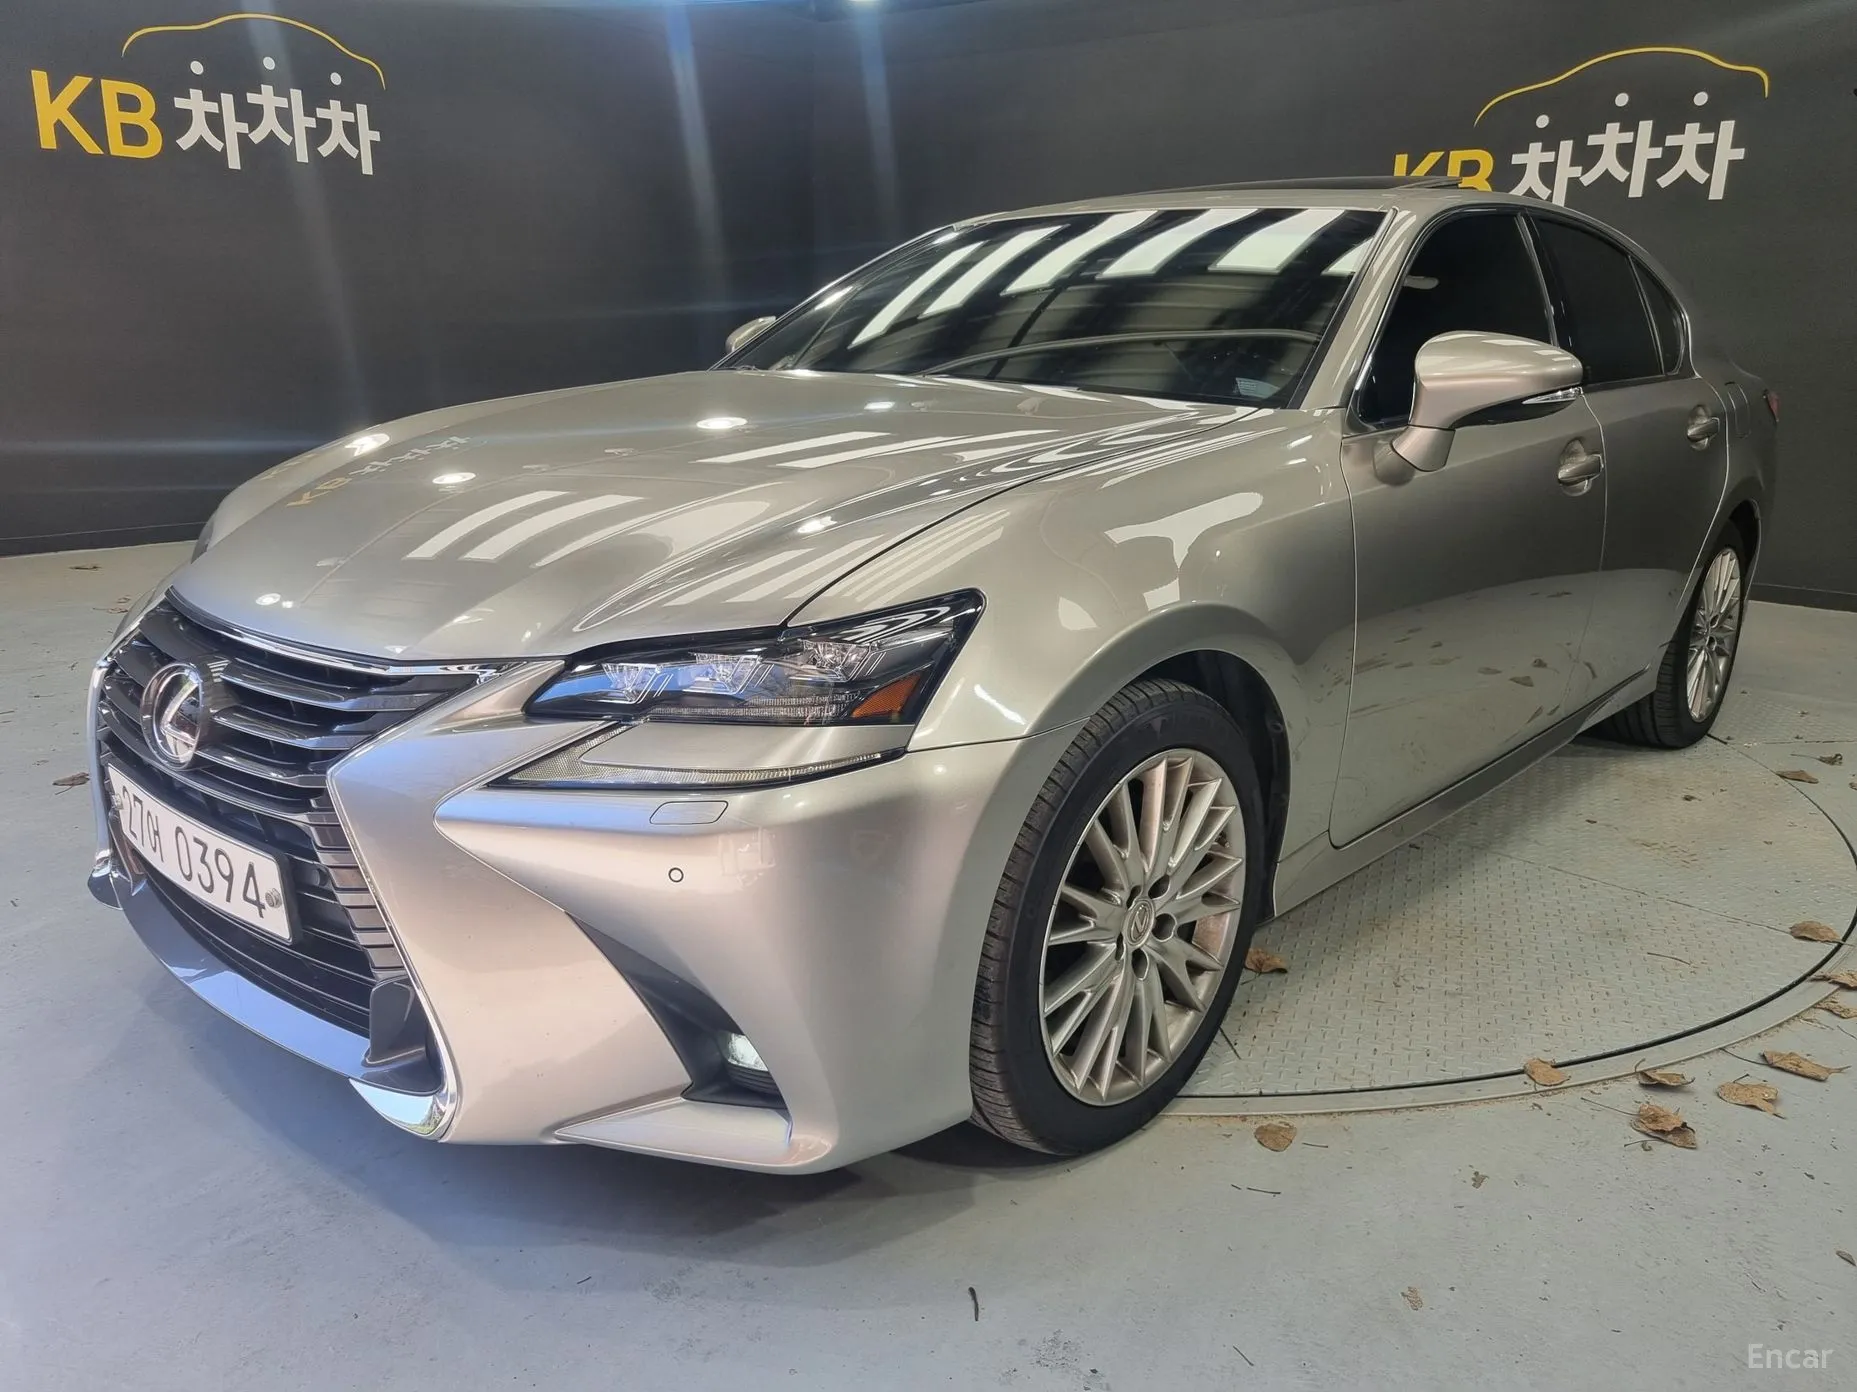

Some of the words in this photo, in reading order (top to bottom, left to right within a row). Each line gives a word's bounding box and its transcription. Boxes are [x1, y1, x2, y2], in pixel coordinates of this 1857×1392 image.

[31, 69, 162, 159] KB
[173, 56, 381, 175] 차차차
[1509, 91, 1746, 207] 차차차
[122, 785, 164, 863] 27어
[175, 825, 266, 919] 0394
